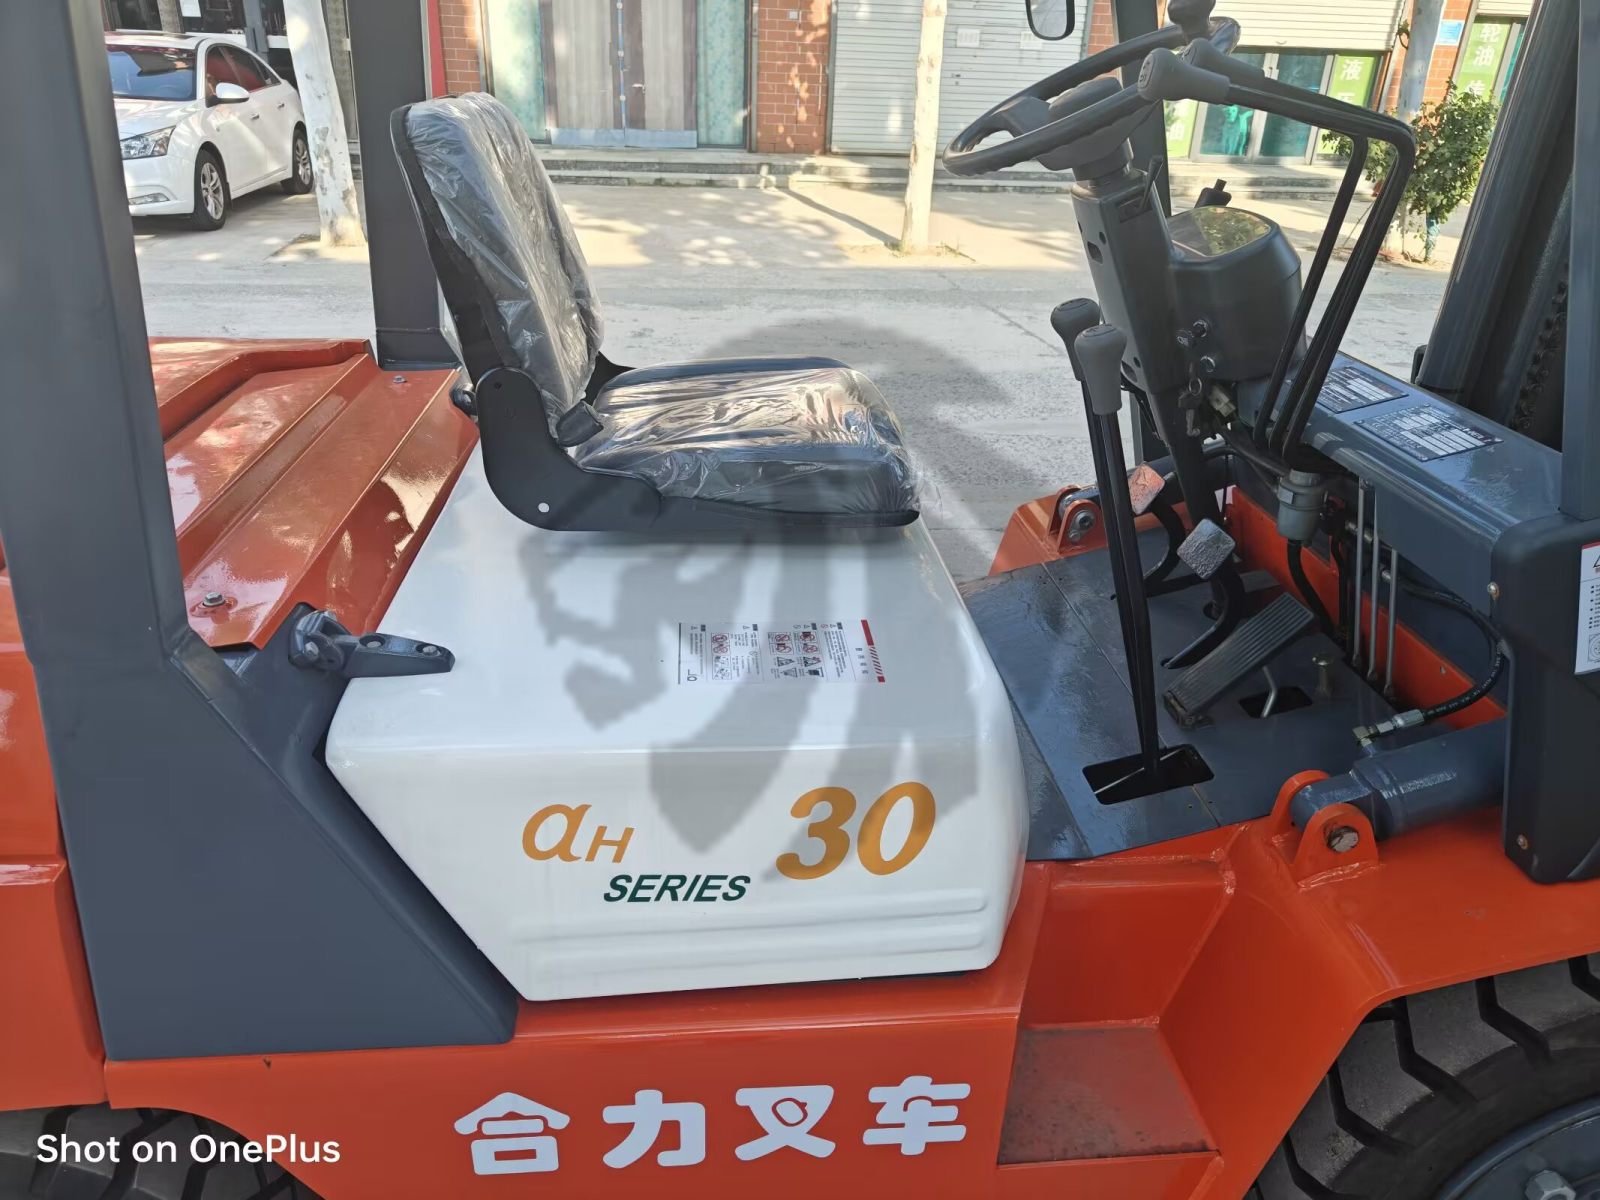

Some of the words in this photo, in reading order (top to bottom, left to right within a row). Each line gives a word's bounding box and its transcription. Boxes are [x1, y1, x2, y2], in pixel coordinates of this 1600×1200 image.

[775, 781, 937, 880] 30
[603, 874, 750, 903] SERIES
[453, 1075, 971, 1176] 合力叉车
